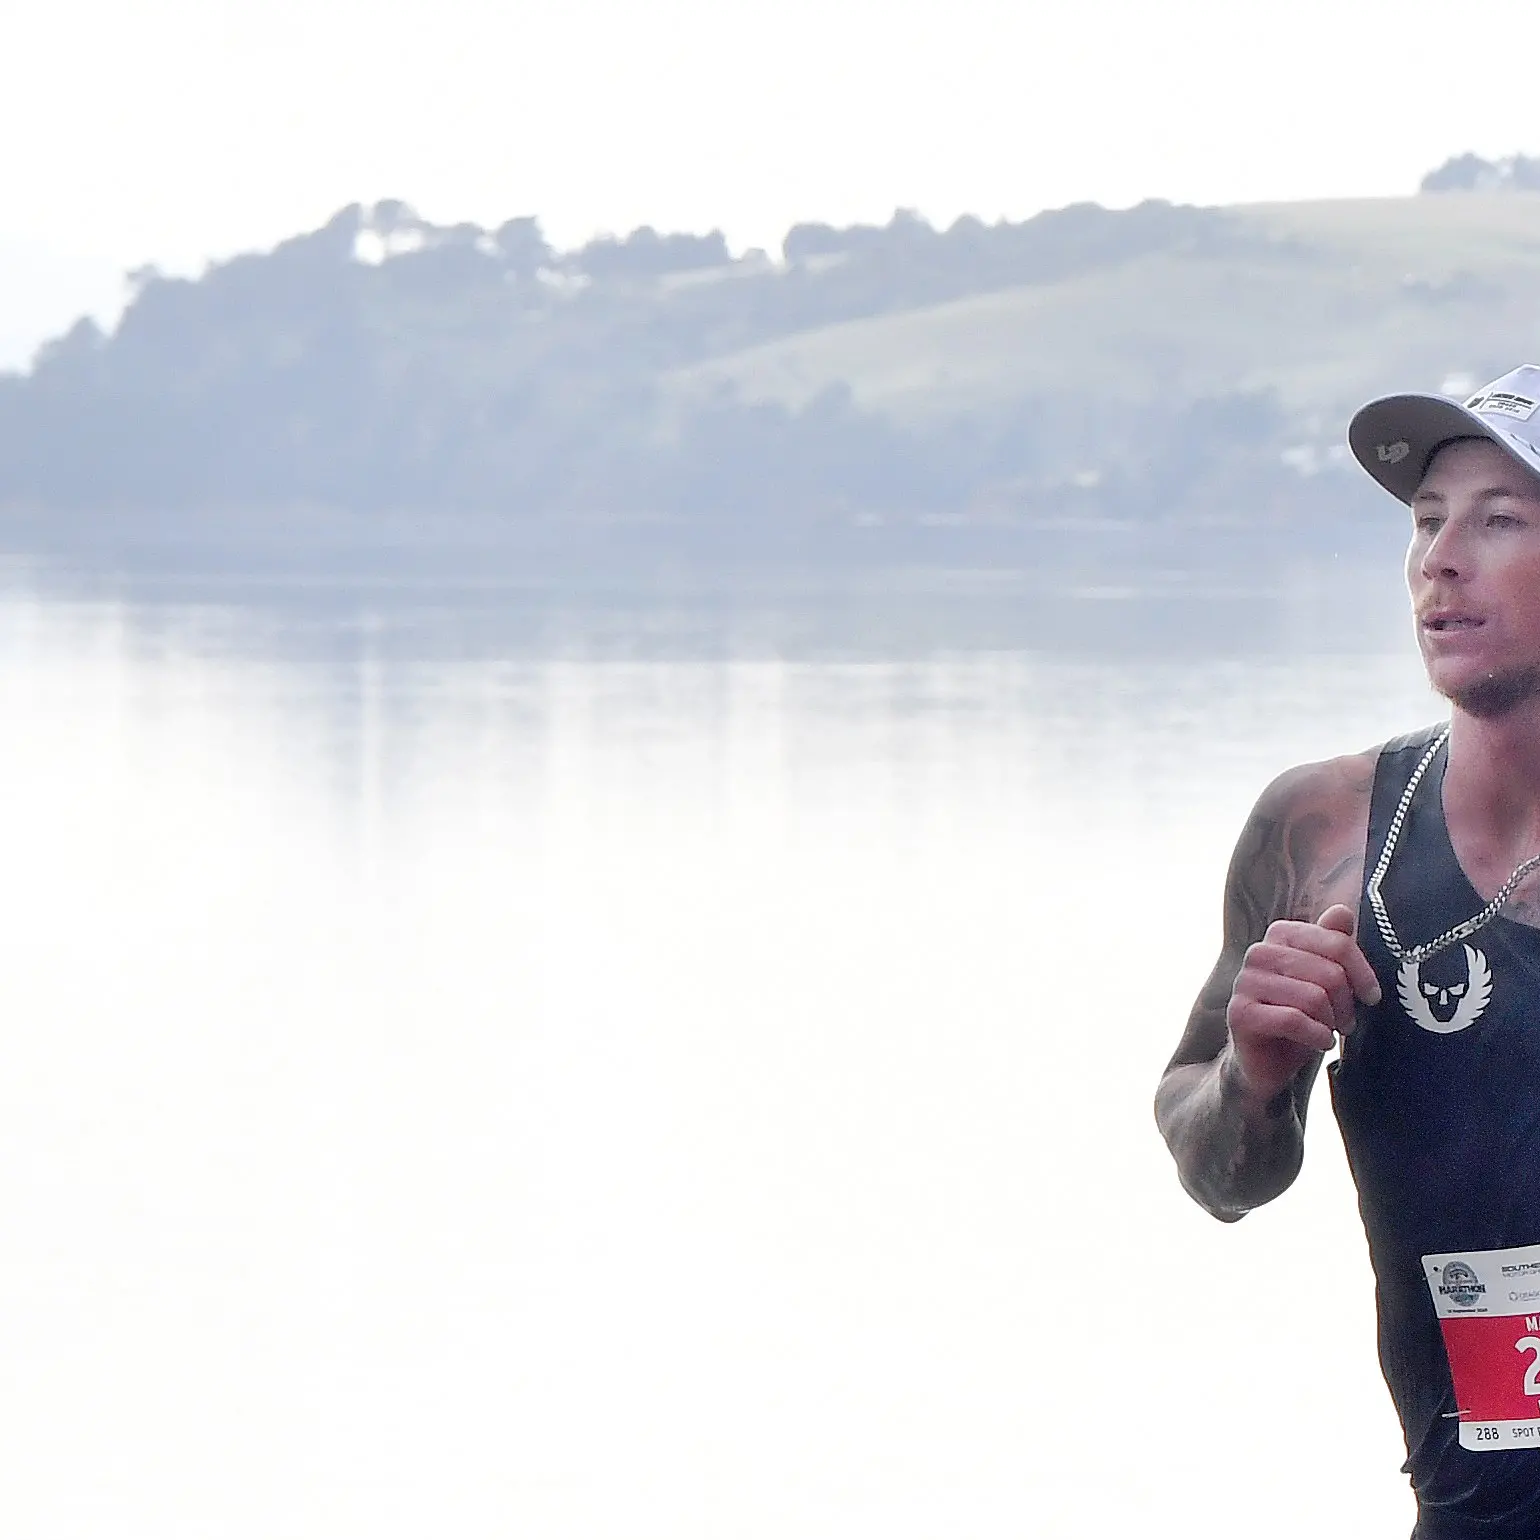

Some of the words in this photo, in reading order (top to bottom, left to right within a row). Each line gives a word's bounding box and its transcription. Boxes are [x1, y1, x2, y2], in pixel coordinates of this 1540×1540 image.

[1439, 1284, 1486, 1295] MARATHON
[1475, 1427, 1500, 1441] 288
[1512, 1427, 1534, 1438] SPOT
